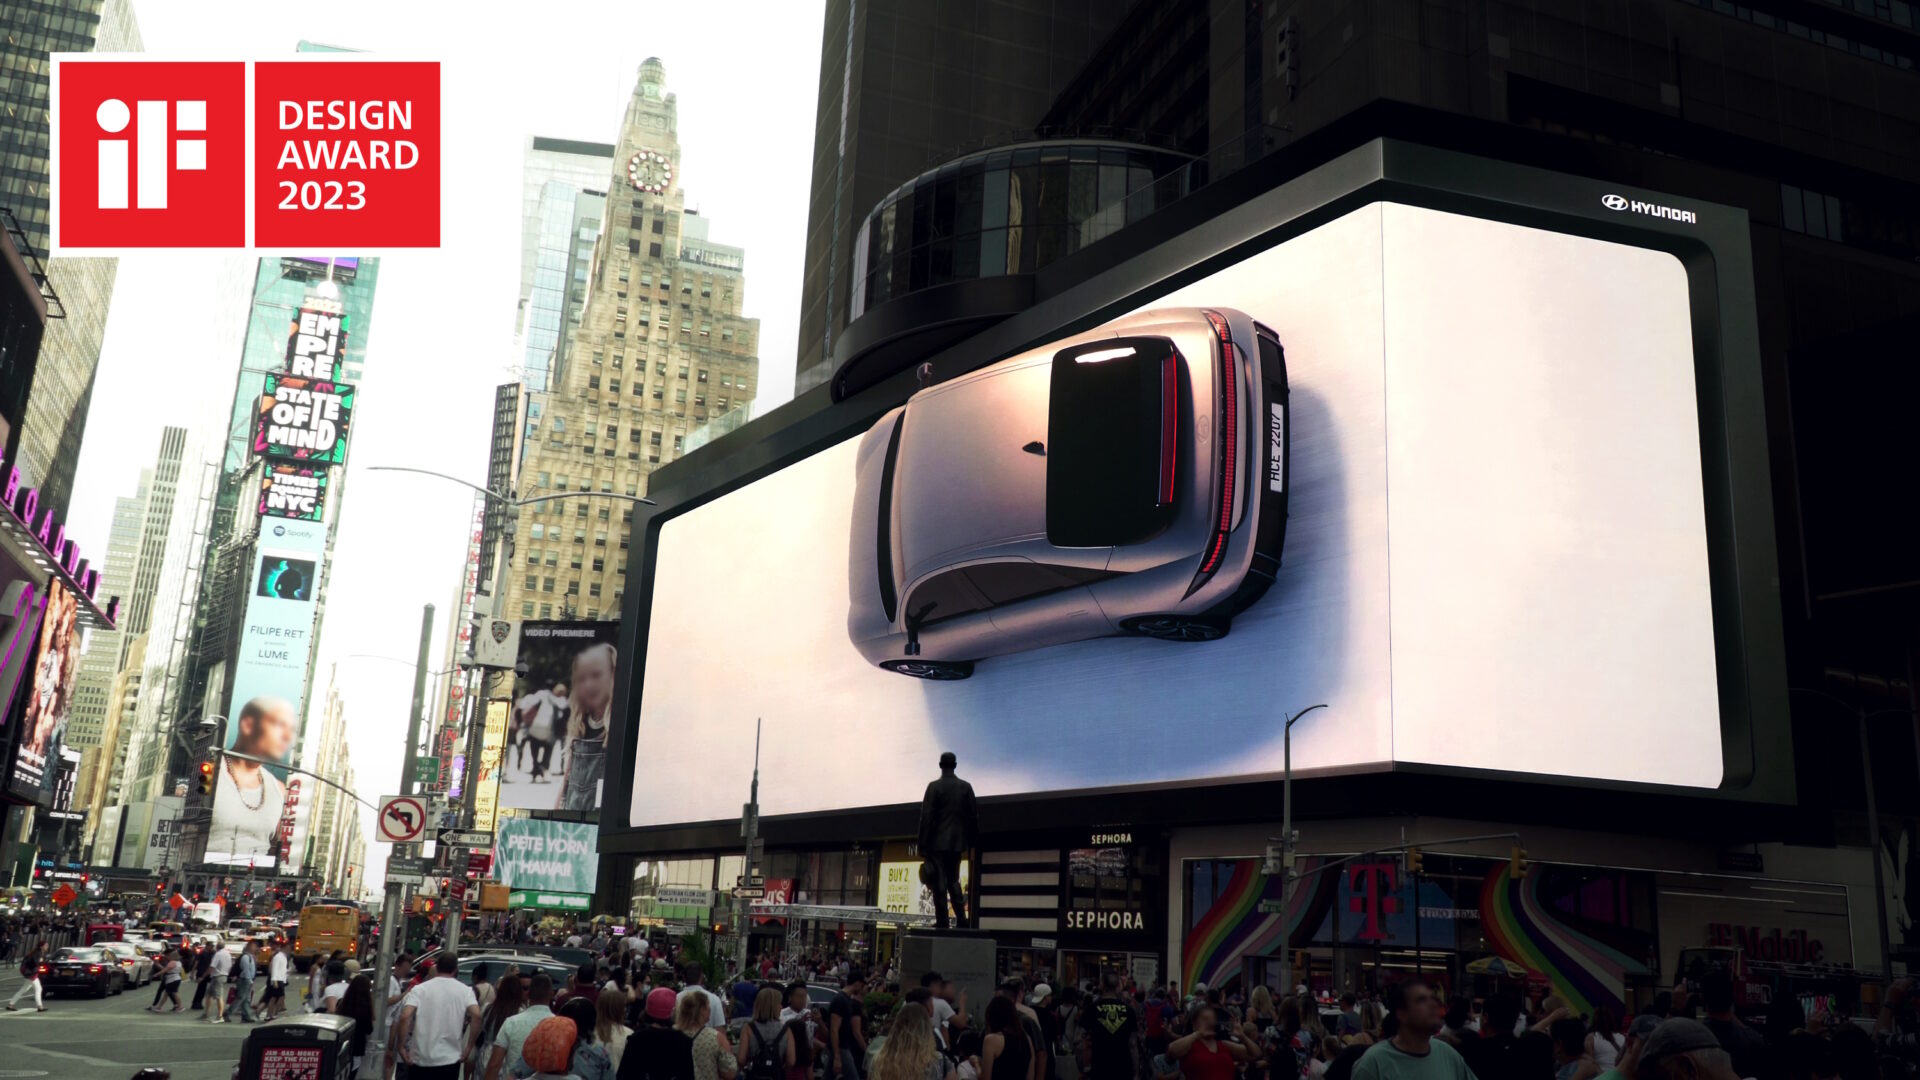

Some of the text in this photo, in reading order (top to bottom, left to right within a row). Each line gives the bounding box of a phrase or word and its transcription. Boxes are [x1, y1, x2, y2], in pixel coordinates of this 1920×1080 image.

[1631, 200, 1696, 224] HYUNDAI
[272, 403, 311, 427] OF
[275, 386, 342, 430] STATE
[267, 419, 336, 451] MIND
[1270, 413, 1281, 448] 2207
[272, 473, 319, 489] TIMES
[267, 492, 316, 512] NYC
[287, 529, 313, 539] Spotify
[250, 625, 304, 638] FILIPE RET
[525, 629, 596, 638] VIDEO PREMIERE
[258, 649, 289, 660] LUME
[445, 832, 488, 843] ONE WAY
[508, 834, 588, 855] PETE YORN
[1091, 833, 1132, 845] SEPHORA
[520, 859, 571, 877] HAWAII
[889, 868, 909, 882] BUY 2
[1067, 911, 1144, 930] SEPHORA
